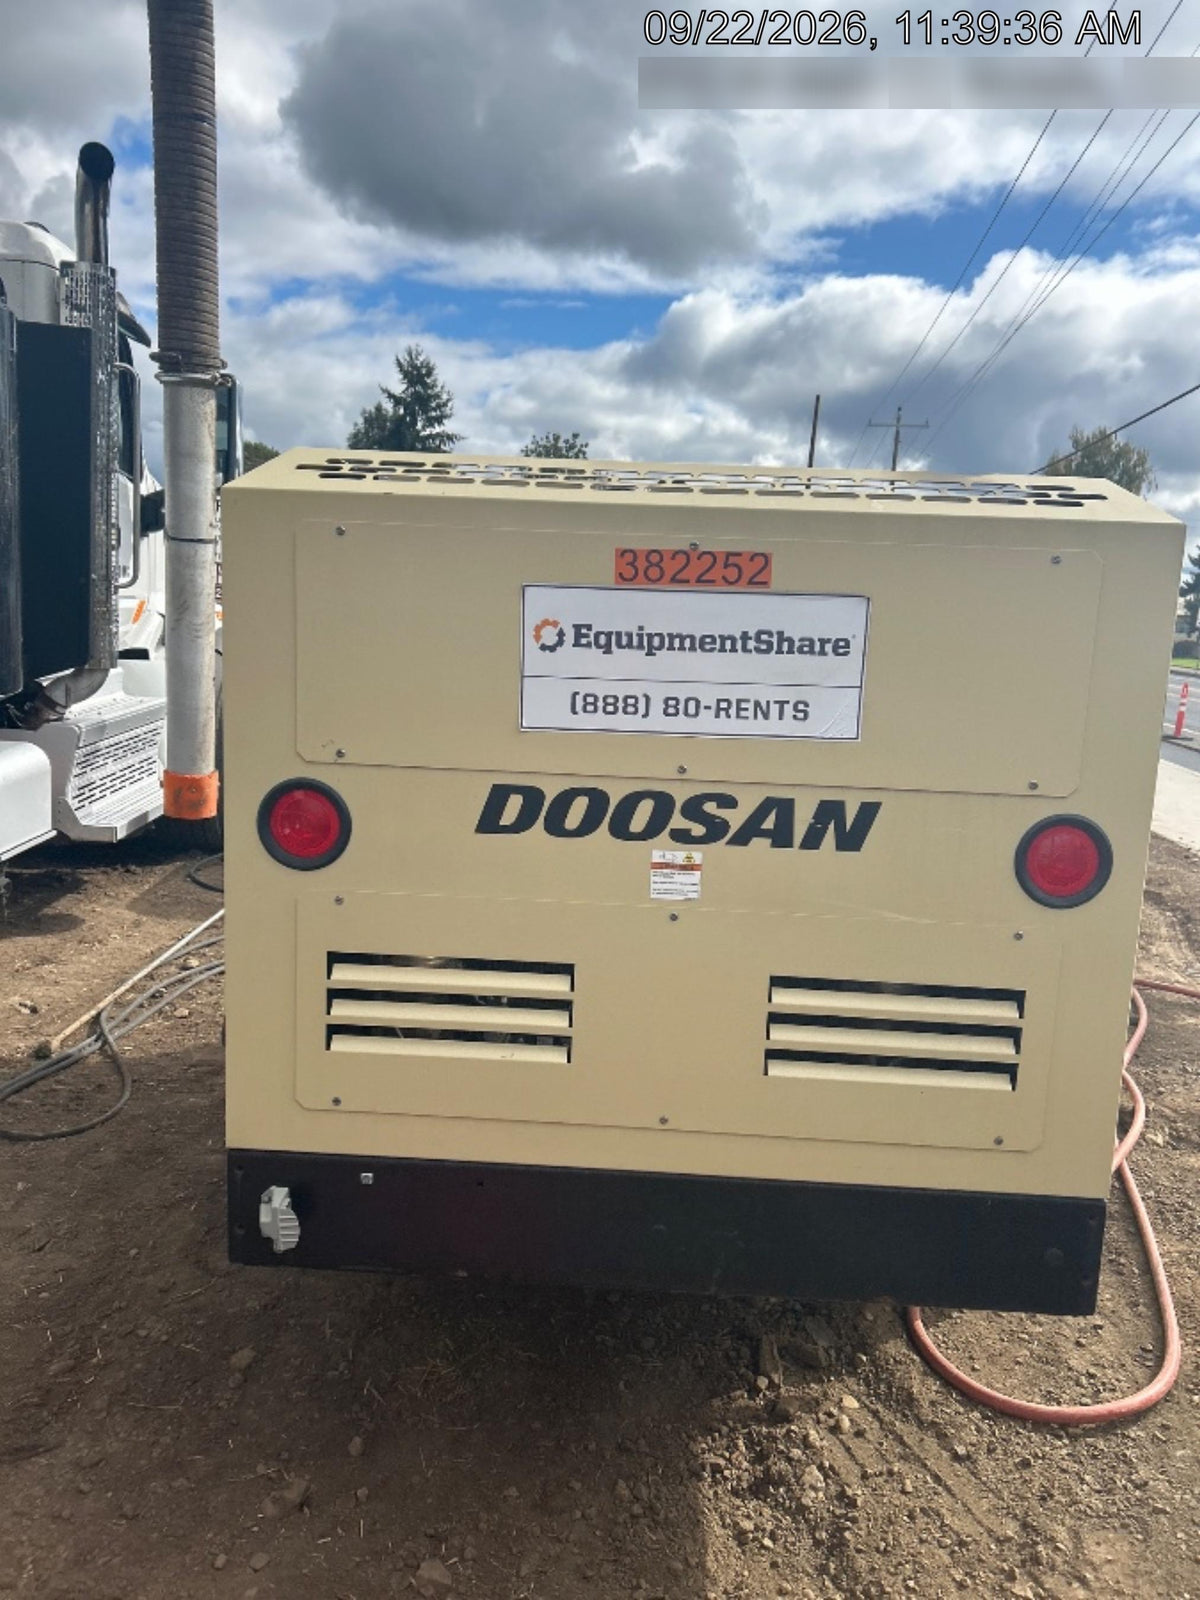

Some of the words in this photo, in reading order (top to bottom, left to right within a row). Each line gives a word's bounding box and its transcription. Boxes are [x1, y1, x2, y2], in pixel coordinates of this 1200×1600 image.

[618, 548, 770, 586] 382252
[571, 623, 851, 657] EquipmentShare
[570, 691, 651, 719] (888)
[662, 696, 810, 722] 80-RENTS
[474, 783, 882, 852] DOOSAN
